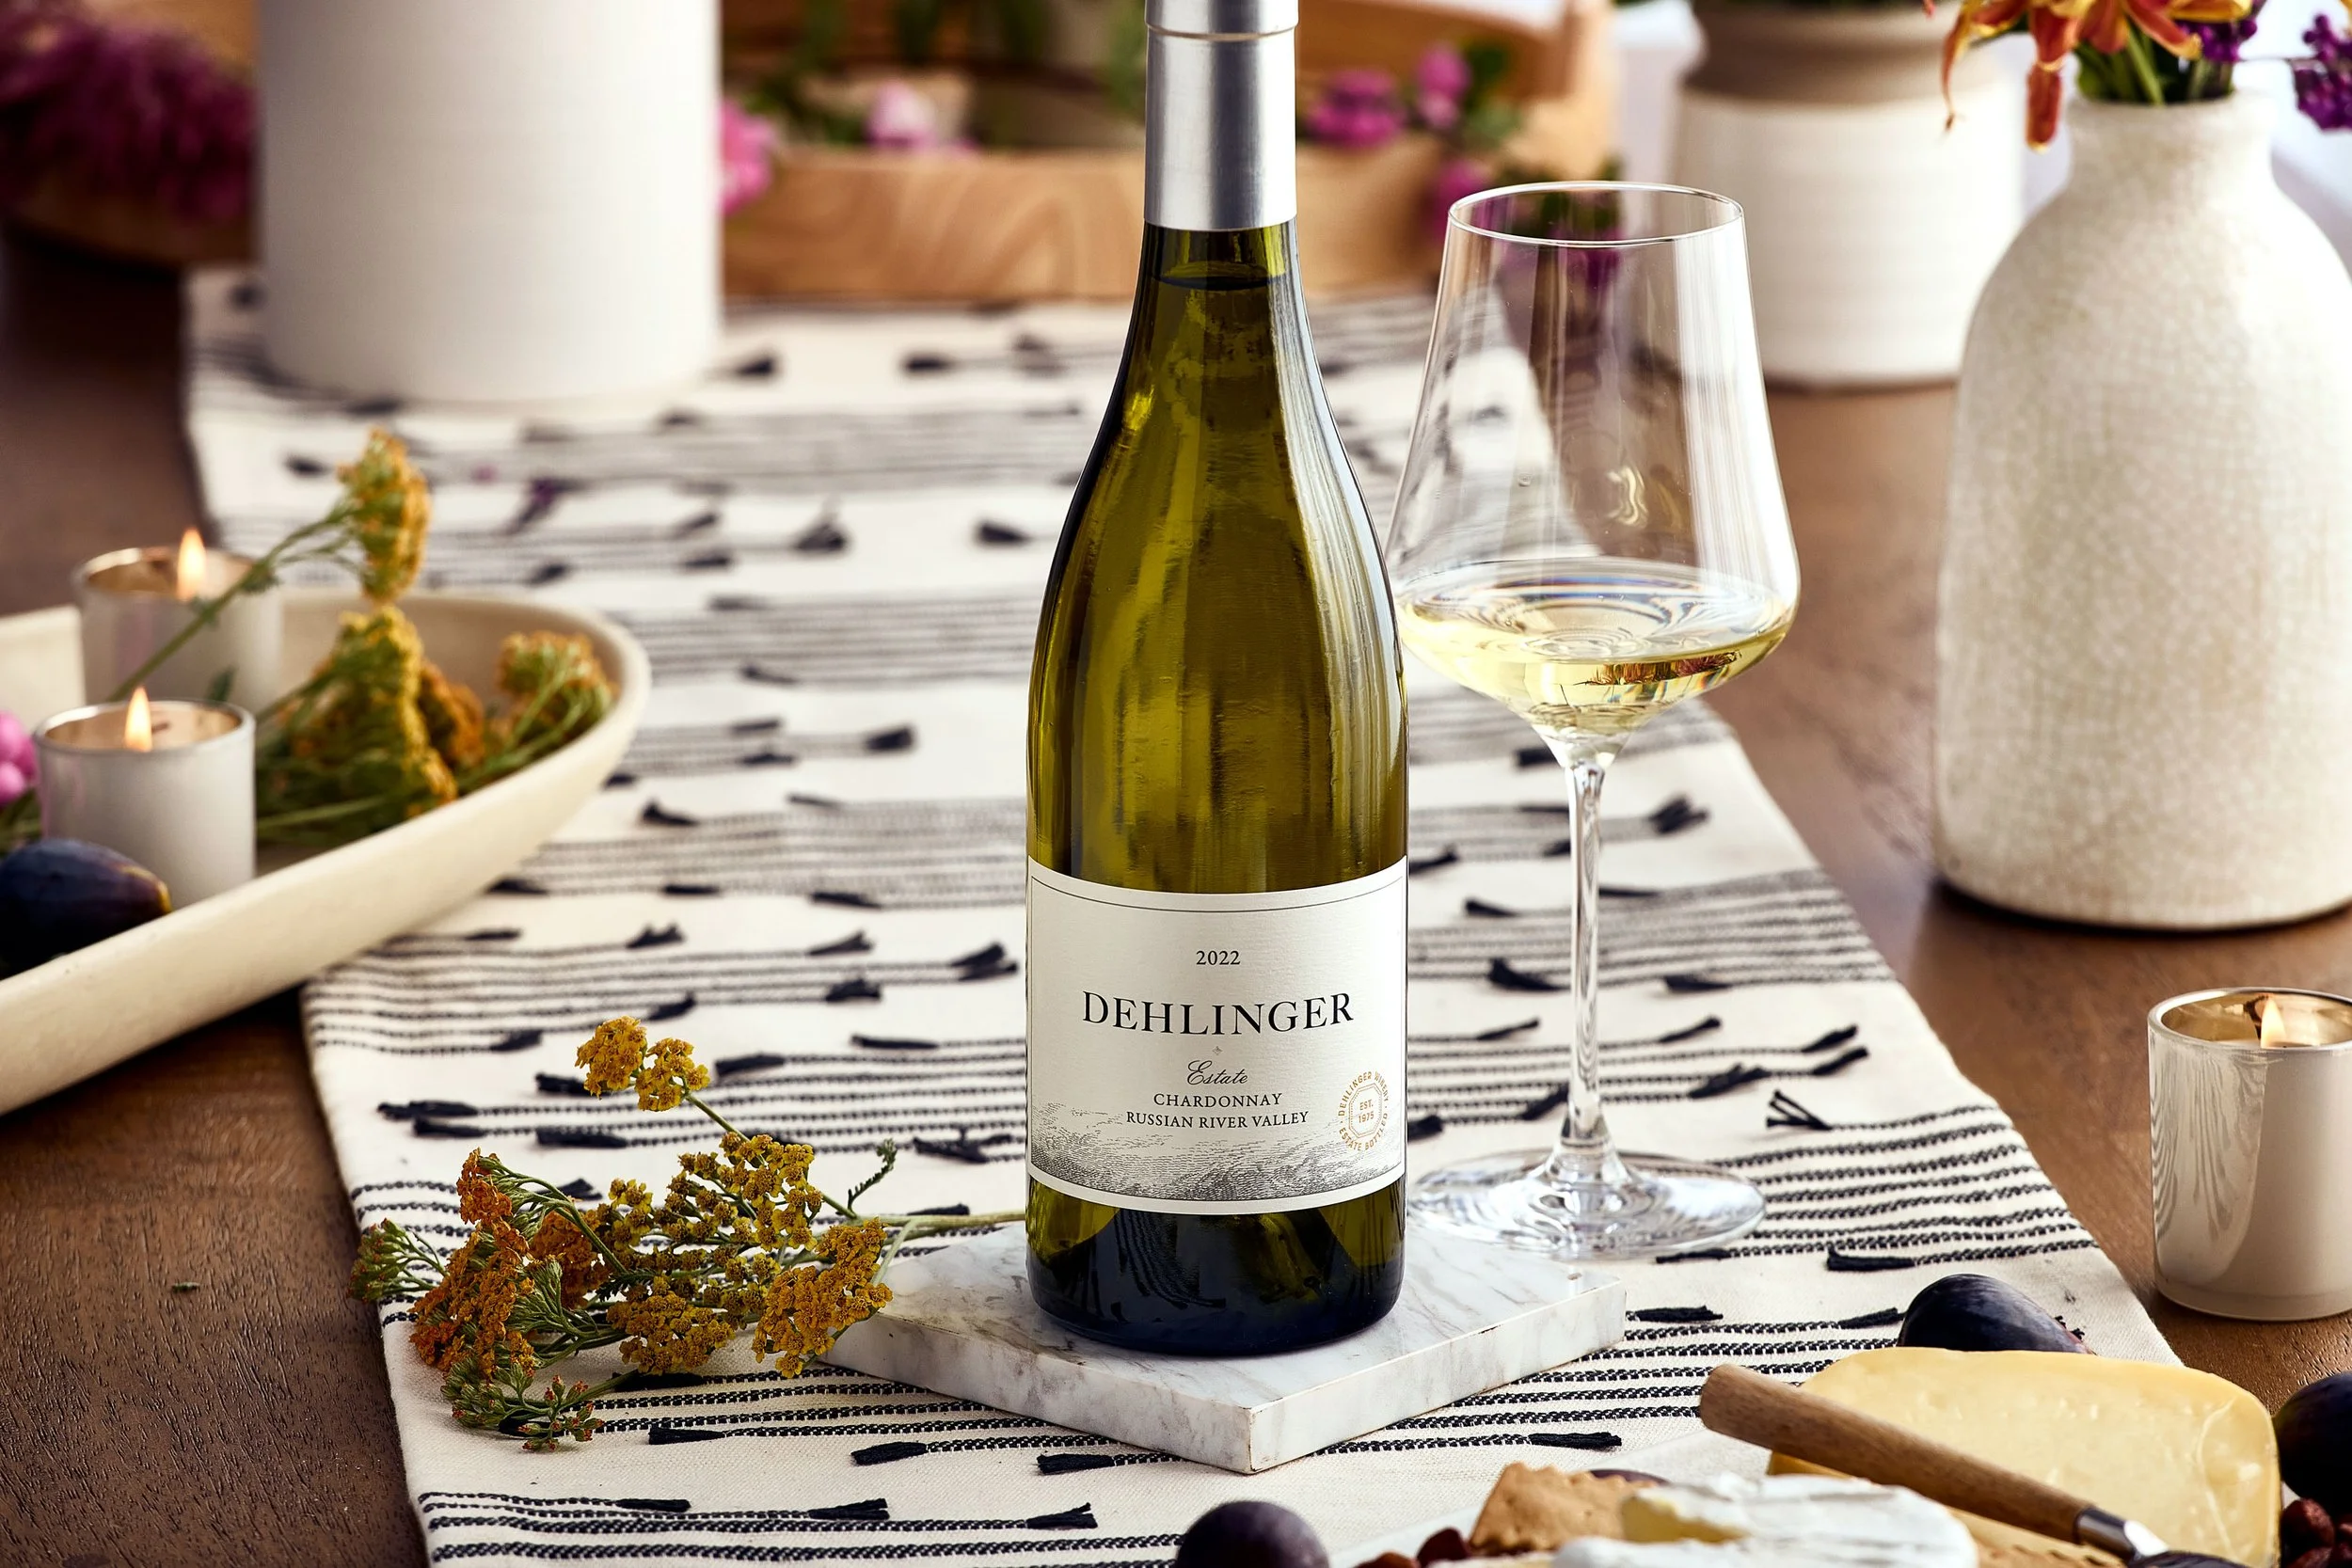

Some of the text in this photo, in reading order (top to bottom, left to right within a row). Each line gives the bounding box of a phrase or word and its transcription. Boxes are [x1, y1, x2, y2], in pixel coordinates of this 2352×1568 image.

[1196, 950, 1241, 966] 2022
[1082, 990, 1354, 1036] DEHLINGER
[1186, 1059, 1249, 1085] Estate
[1153, 1092, 1282, 1108] CHARDONNAY
[1338, 1070, 1390, 1117] DEHLINGER WINERY
[1359, 1099, 1374, 1111] EST.
[1126, 1110, 1310, 1129] RUSSIAN RIVER VALLEY
[1358, 1111, 1375, 1124] 1975
[1339, 1112, 1389, 1151] ESTATE BOTTLED
